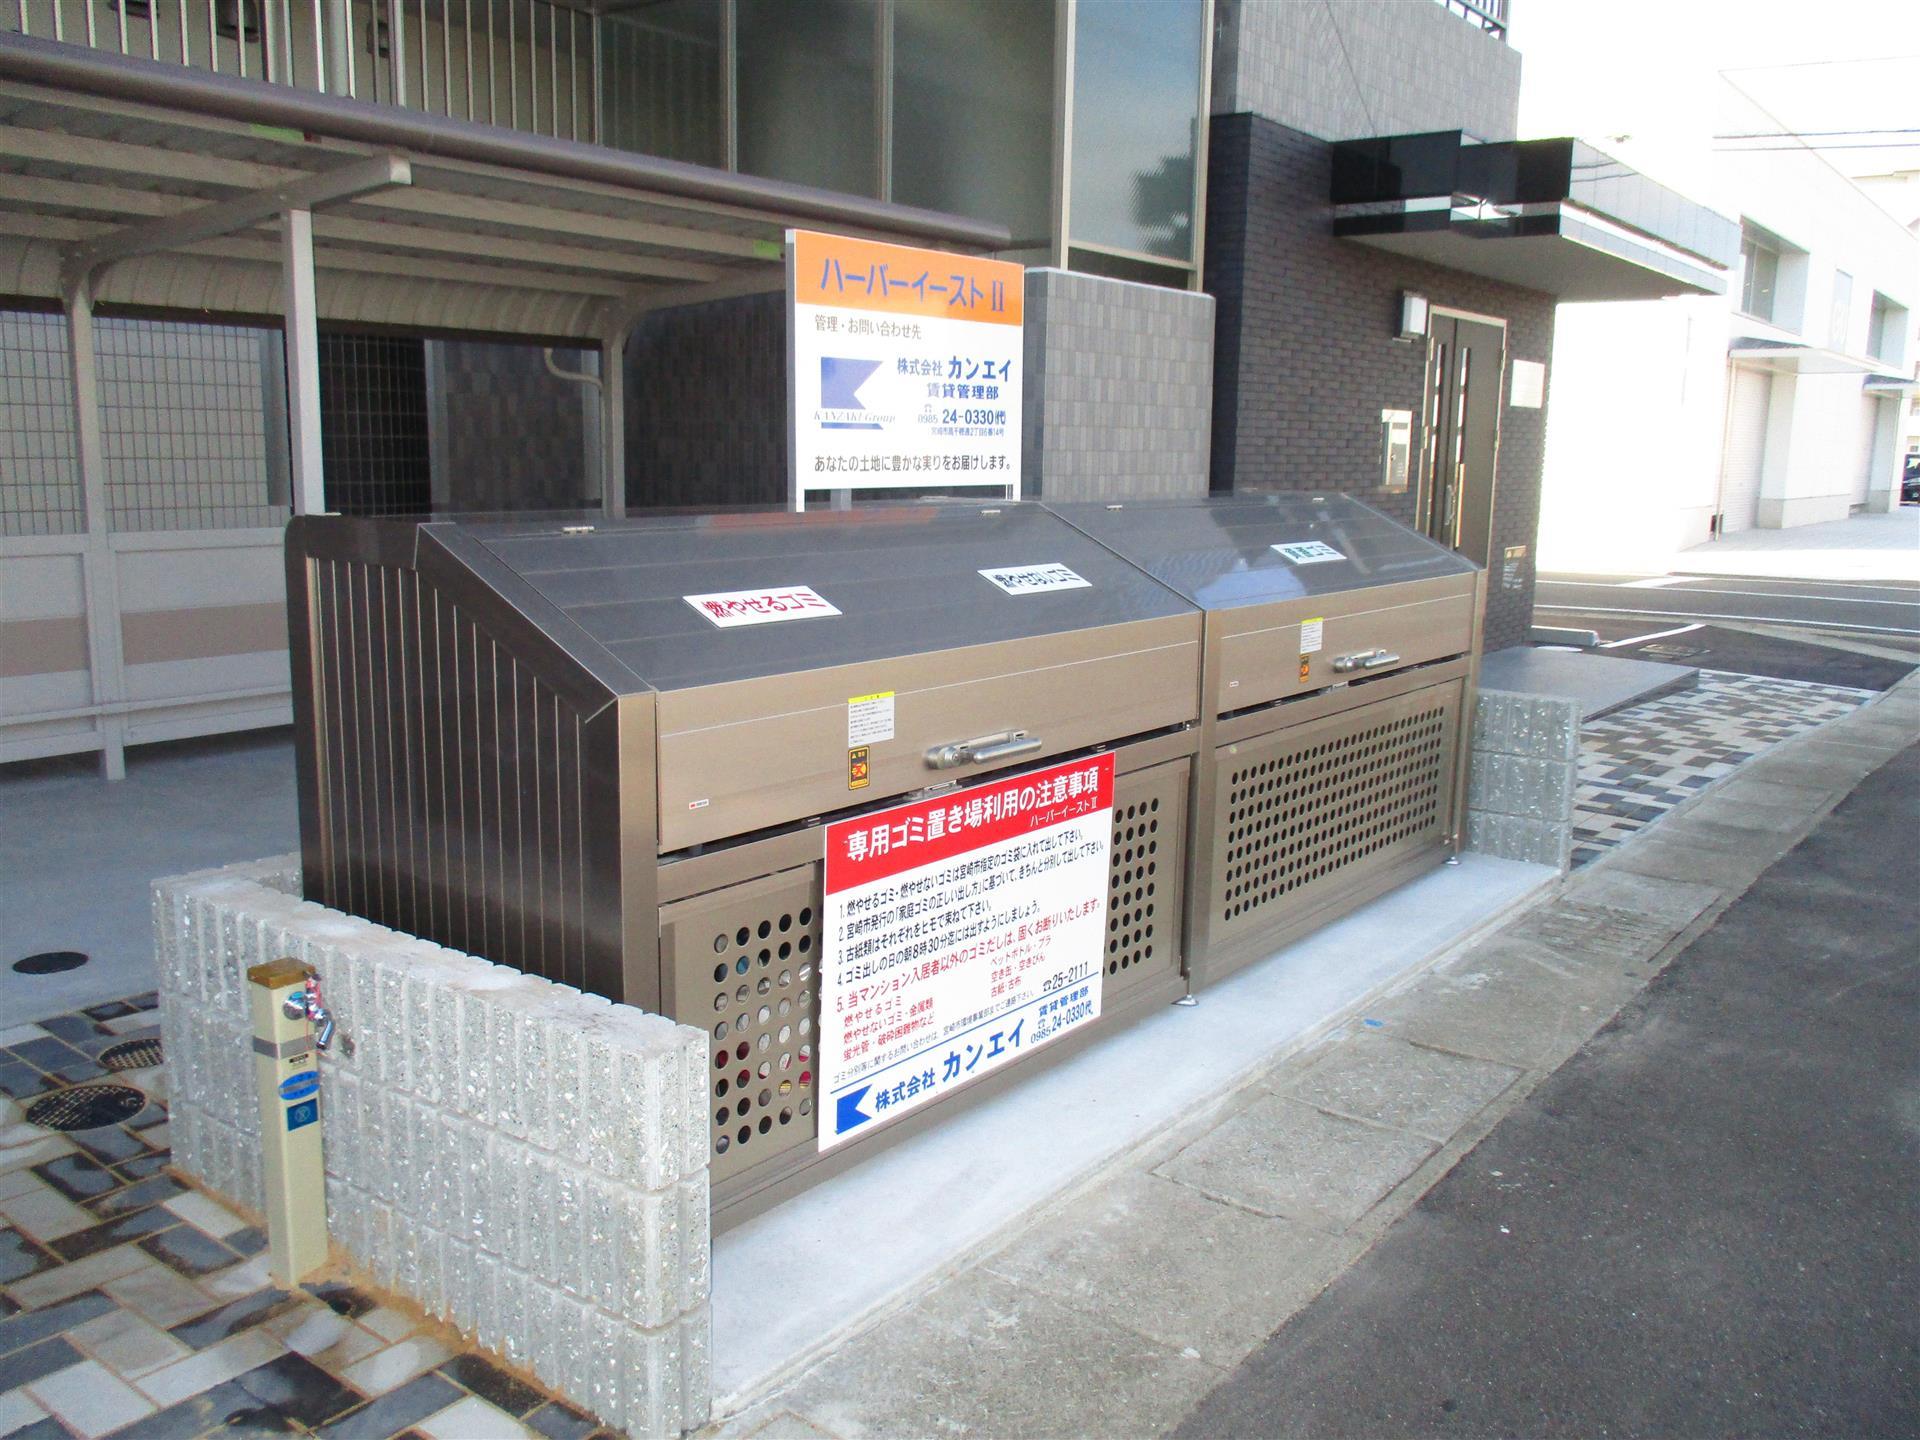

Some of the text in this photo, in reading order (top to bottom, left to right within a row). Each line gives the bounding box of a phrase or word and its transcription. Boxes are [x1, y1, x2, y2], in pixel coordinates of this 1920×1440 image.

[815, 314, 922, 340] 管理・お問い合わせ先
[897, 355, 1012, 382] 株式会社 カンエイ
[927, 383, 999, 400] 賃貸管理部
[917, 414, 938, 424] 0985
[814, 454, 1011, 472] あなたの土地に豊かな実りをお届けします。
[701, 593, 827, 618] 燃やせるゴミ
[847, 766, 1100, 862] 専用ゴミ置き場利用の注意事項
[844, 995, 902, 1028] 燃やせるゴミ
[1039, 986, 1089, 1018] 賃貸管理部
[1031, 1026, 1051, 1044] 0985
[875, 1018, 1025, 1113] 株式会社 カンエイ
